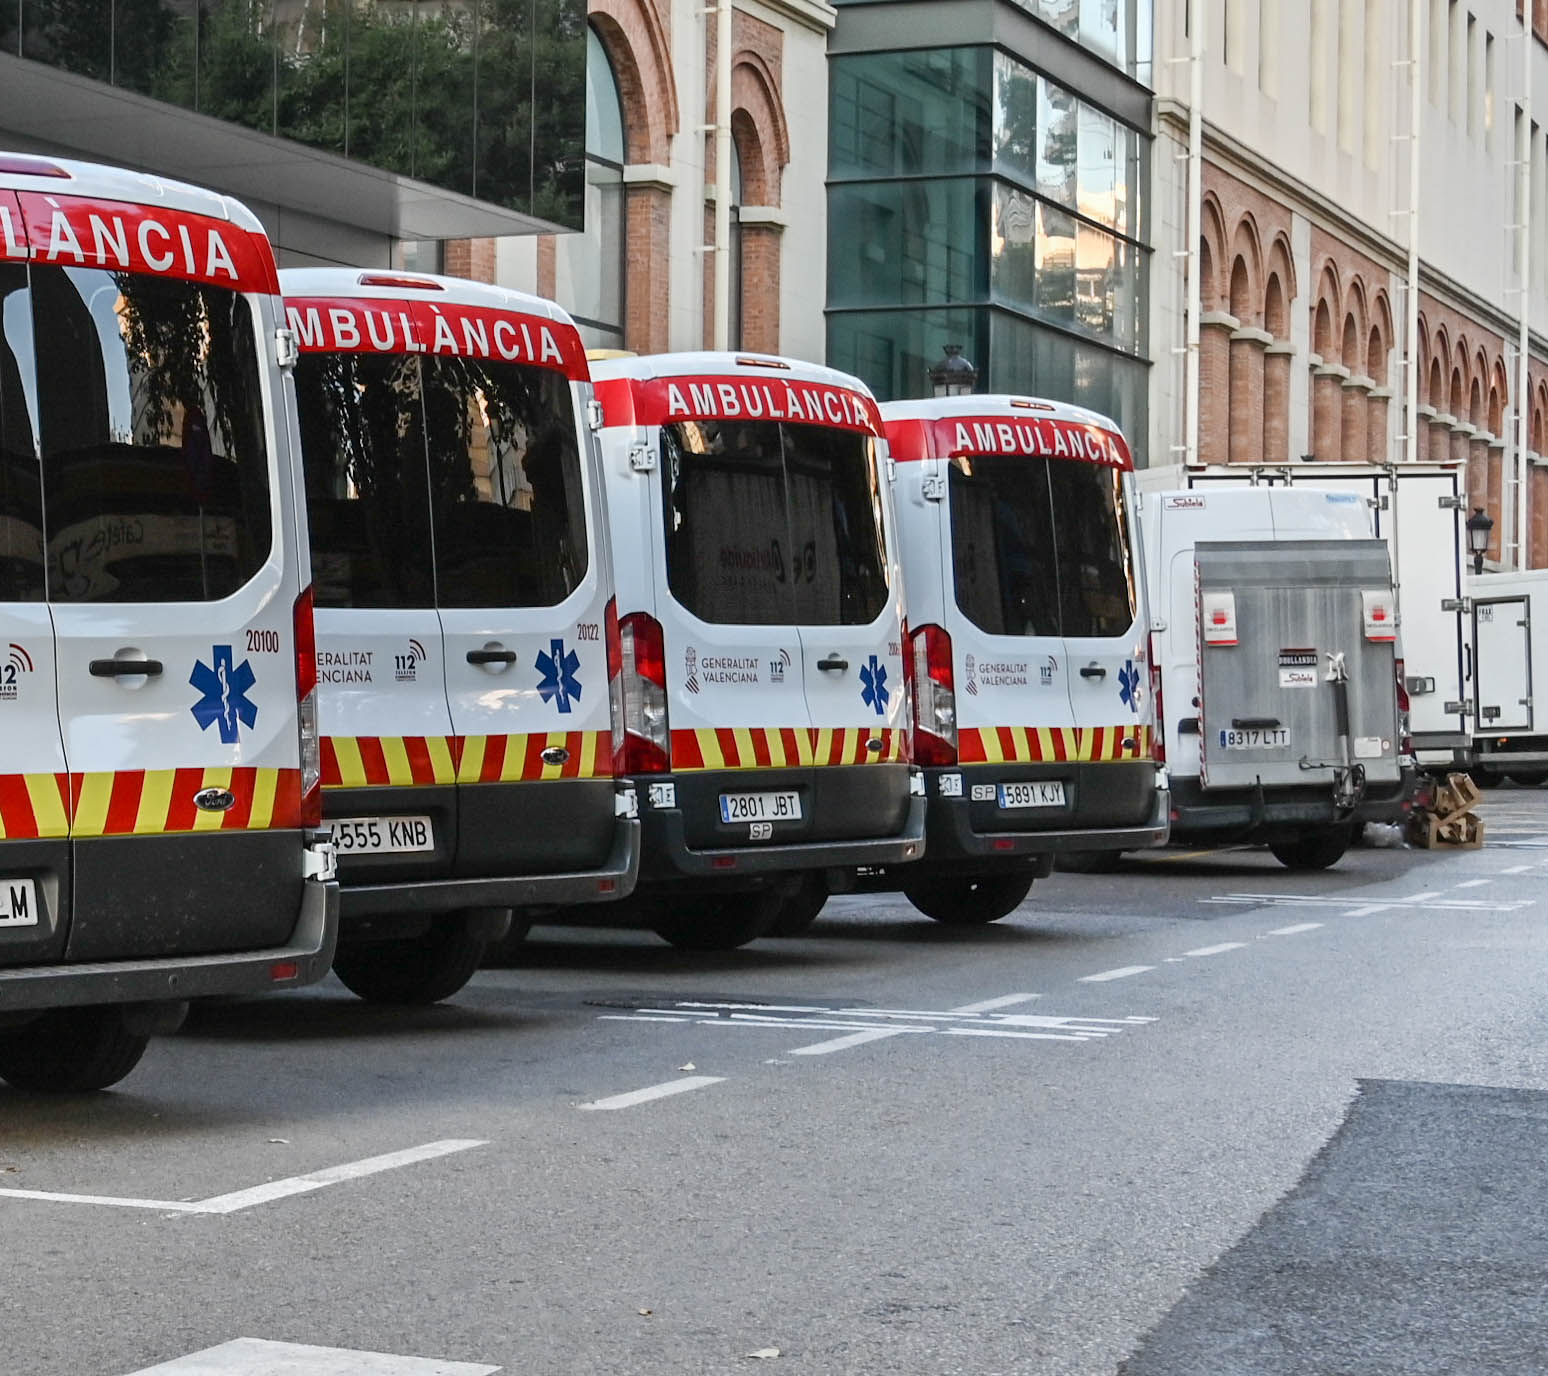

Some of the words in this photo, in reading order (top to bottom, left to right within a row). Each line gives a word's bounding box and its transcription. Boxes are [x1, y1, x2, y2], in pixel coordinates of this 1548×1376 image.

[668, 379, 872, 428] AMBULÀNCIA
[955, 420, 1124, 465] AMBULÀNCIA
[577, 623, 599, 641] 20122
[246, 629, 279, 653] 20100
[394, 654, 416, 670] 112
[701, 657, 759, 670] GENERALITAT
[770, 661, 784, 674] 112
[979, 663, 1027, 674] GENERALITAT
[703, 671, 759, 683] VALENCIANA
[1040, 666, 1052, 678] 112
[980, 676, 1028, 686] VALENCIANA
[1228, 730, 1259, 745] 8317
[1264, 730, 1286, 745] LTT
[973, 786, 994, 799] SP
[1006, 785, 1036, 804] 5891
[1040, 783, 1061, 803] KJY
[730, 796, 765, 818] 2801
[772, 795, 795, 816] JBT
[388, 821, 427, 847] KNB
[751, 824, 771, 838] SP
